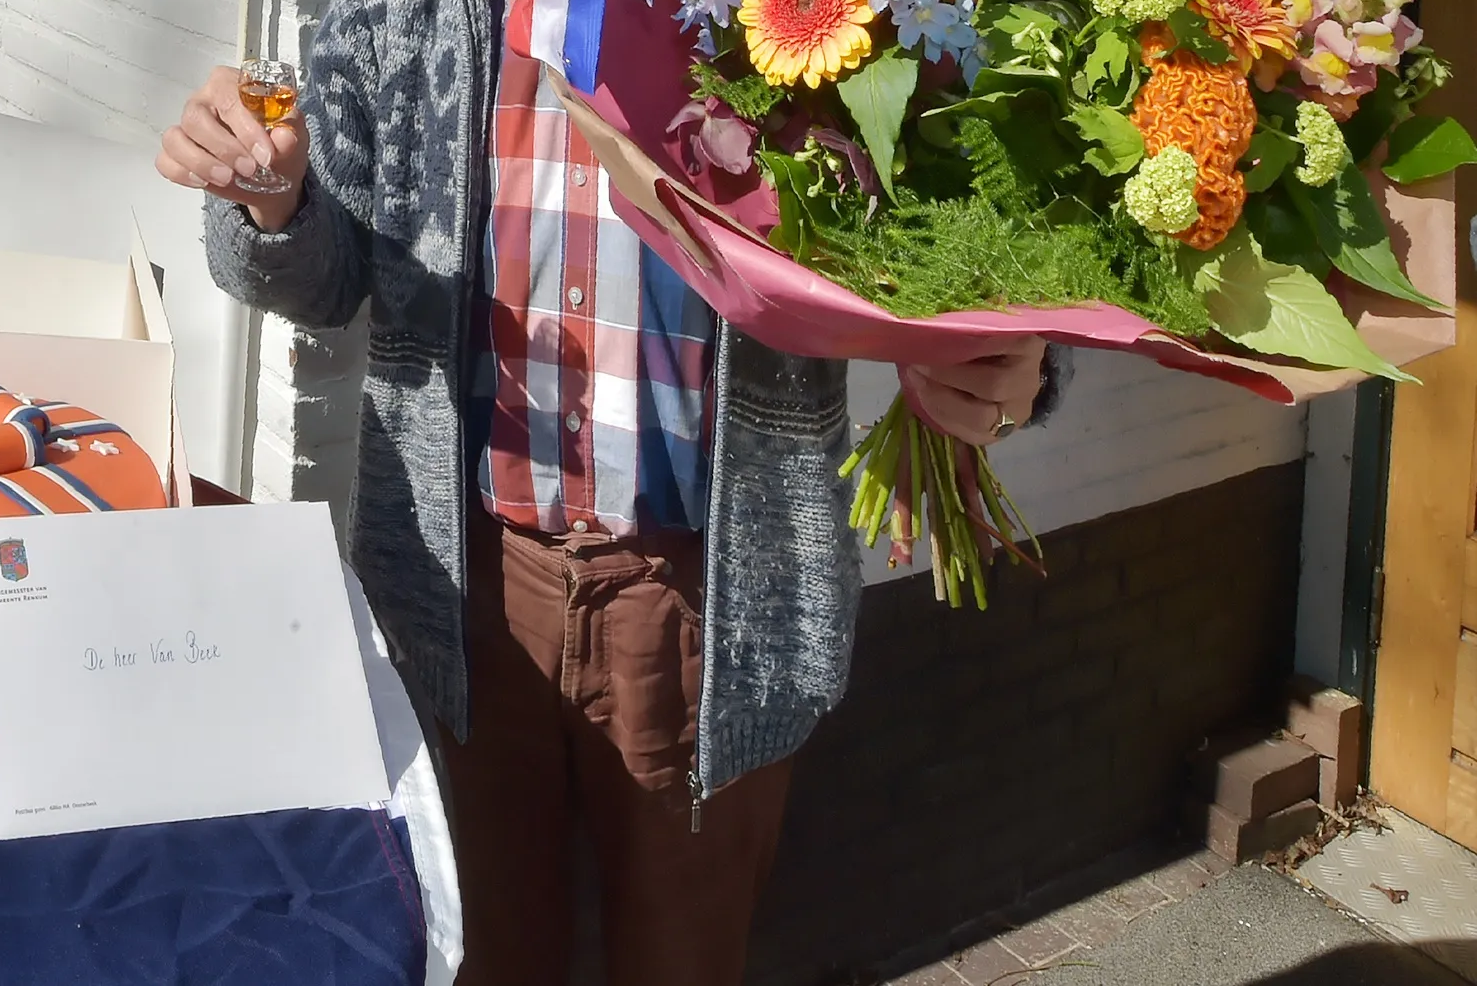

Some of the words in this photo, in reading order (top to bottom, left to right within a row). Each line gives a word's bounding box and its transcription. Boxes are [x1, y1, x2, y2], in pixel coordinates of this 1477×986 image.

[83, 647, 105, 671] De
[114, 647, 138, 667] heer
[150, 638, 175, 664] Van
